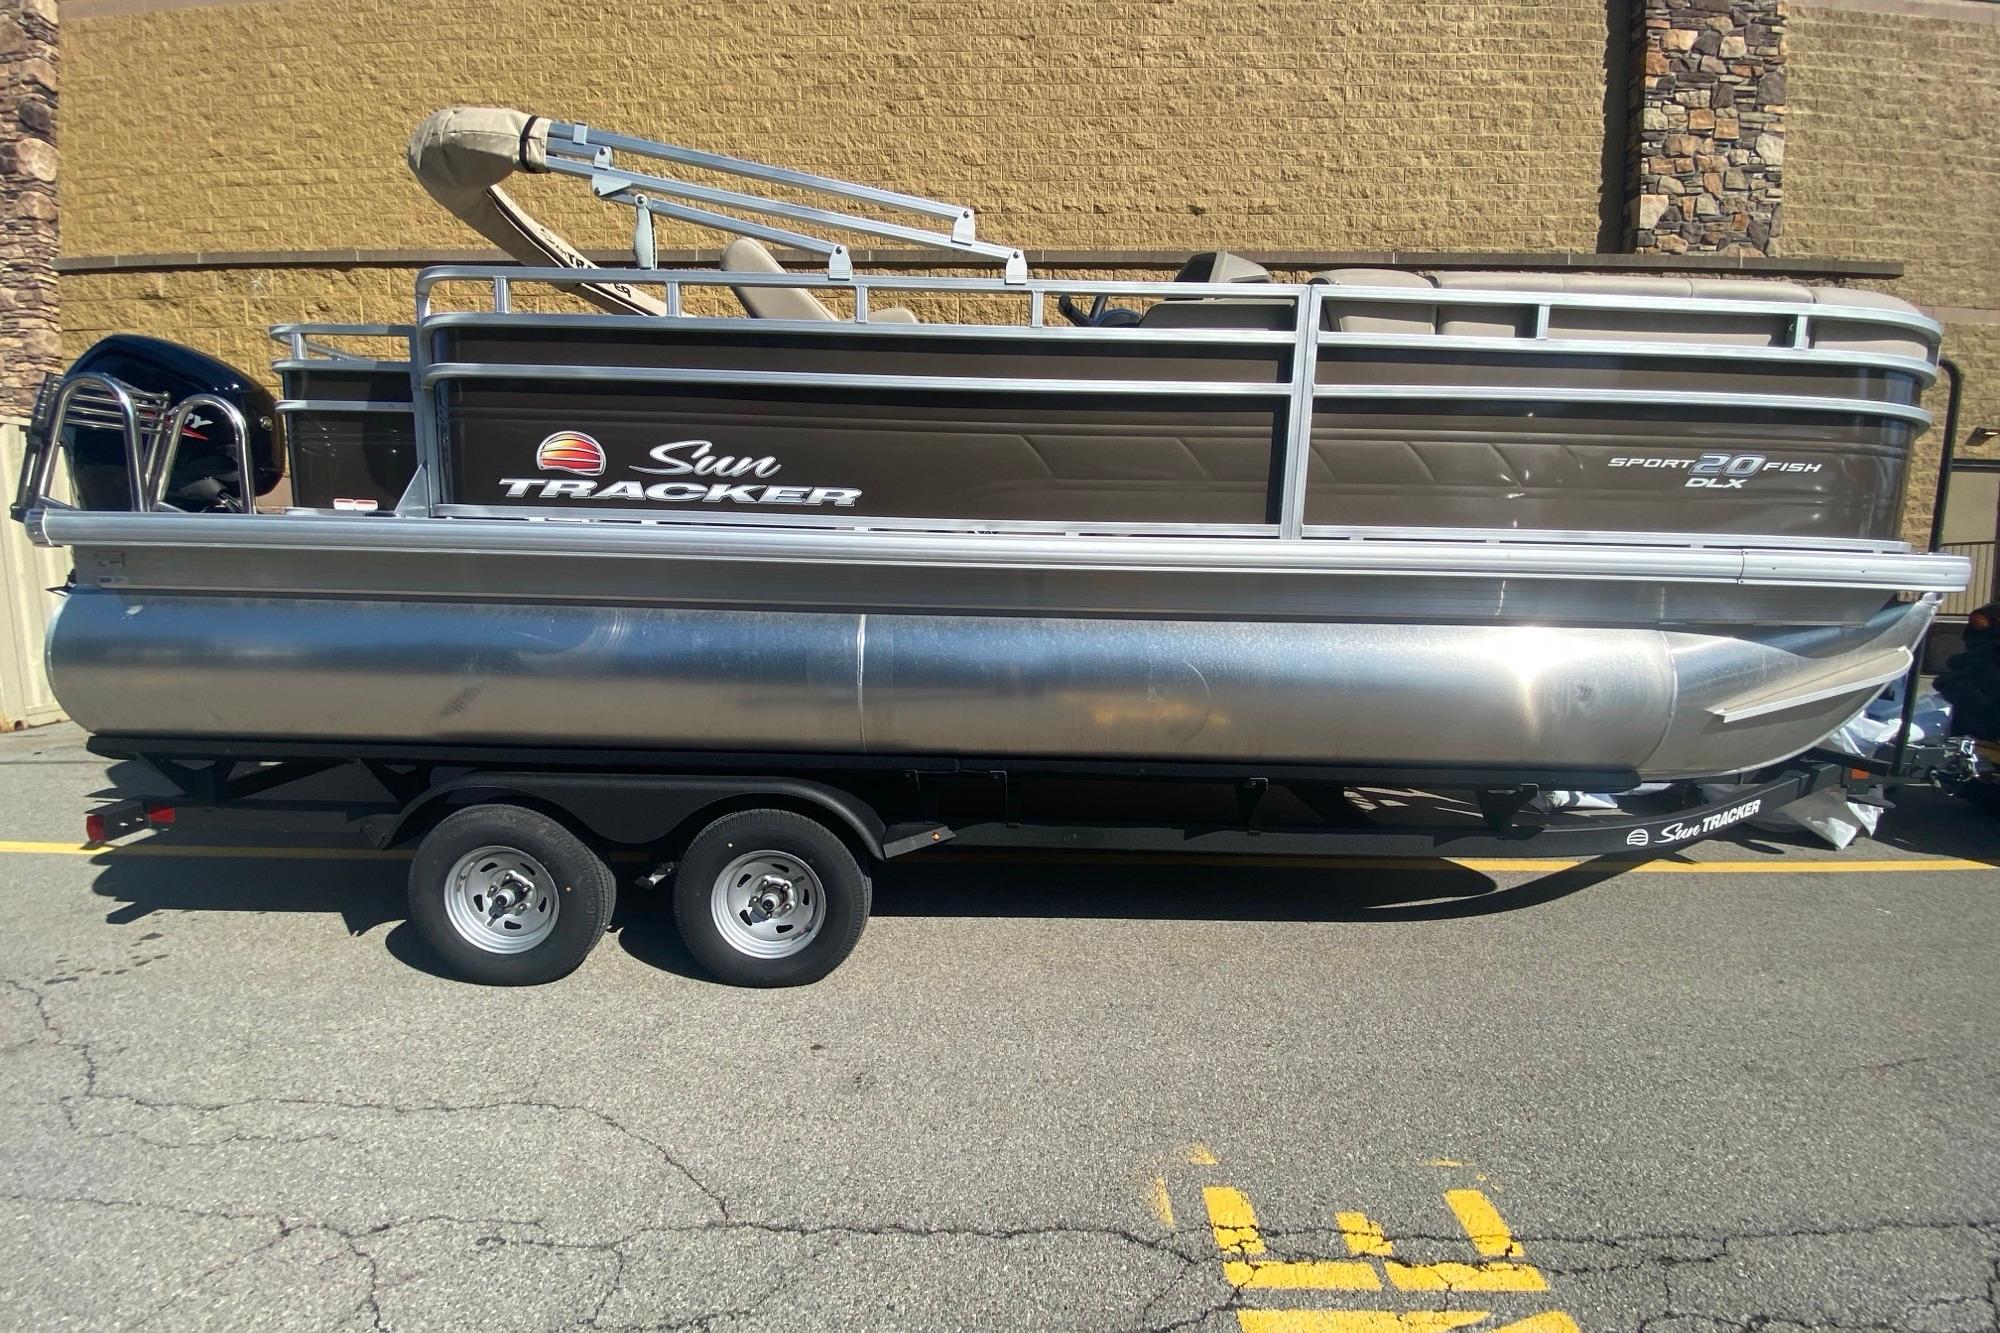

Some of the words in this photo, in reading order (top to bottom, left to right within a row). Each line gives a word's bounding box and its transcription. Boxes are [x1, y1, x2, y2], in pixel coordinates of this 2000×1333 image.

[628, 439, 782, 478] Sun
[1607, 457, 1696, 469] SPORT
[1687, 453, 1767, 477] 20
[1762, 462, 1822, 473] FISH
[499, 478, 864, 507] TRACKER
[1685, 477, 1747, 489] DLX
[1653, 822, 1701, 844] Sun
[1702, 799, 1761, 832] TRACKER
